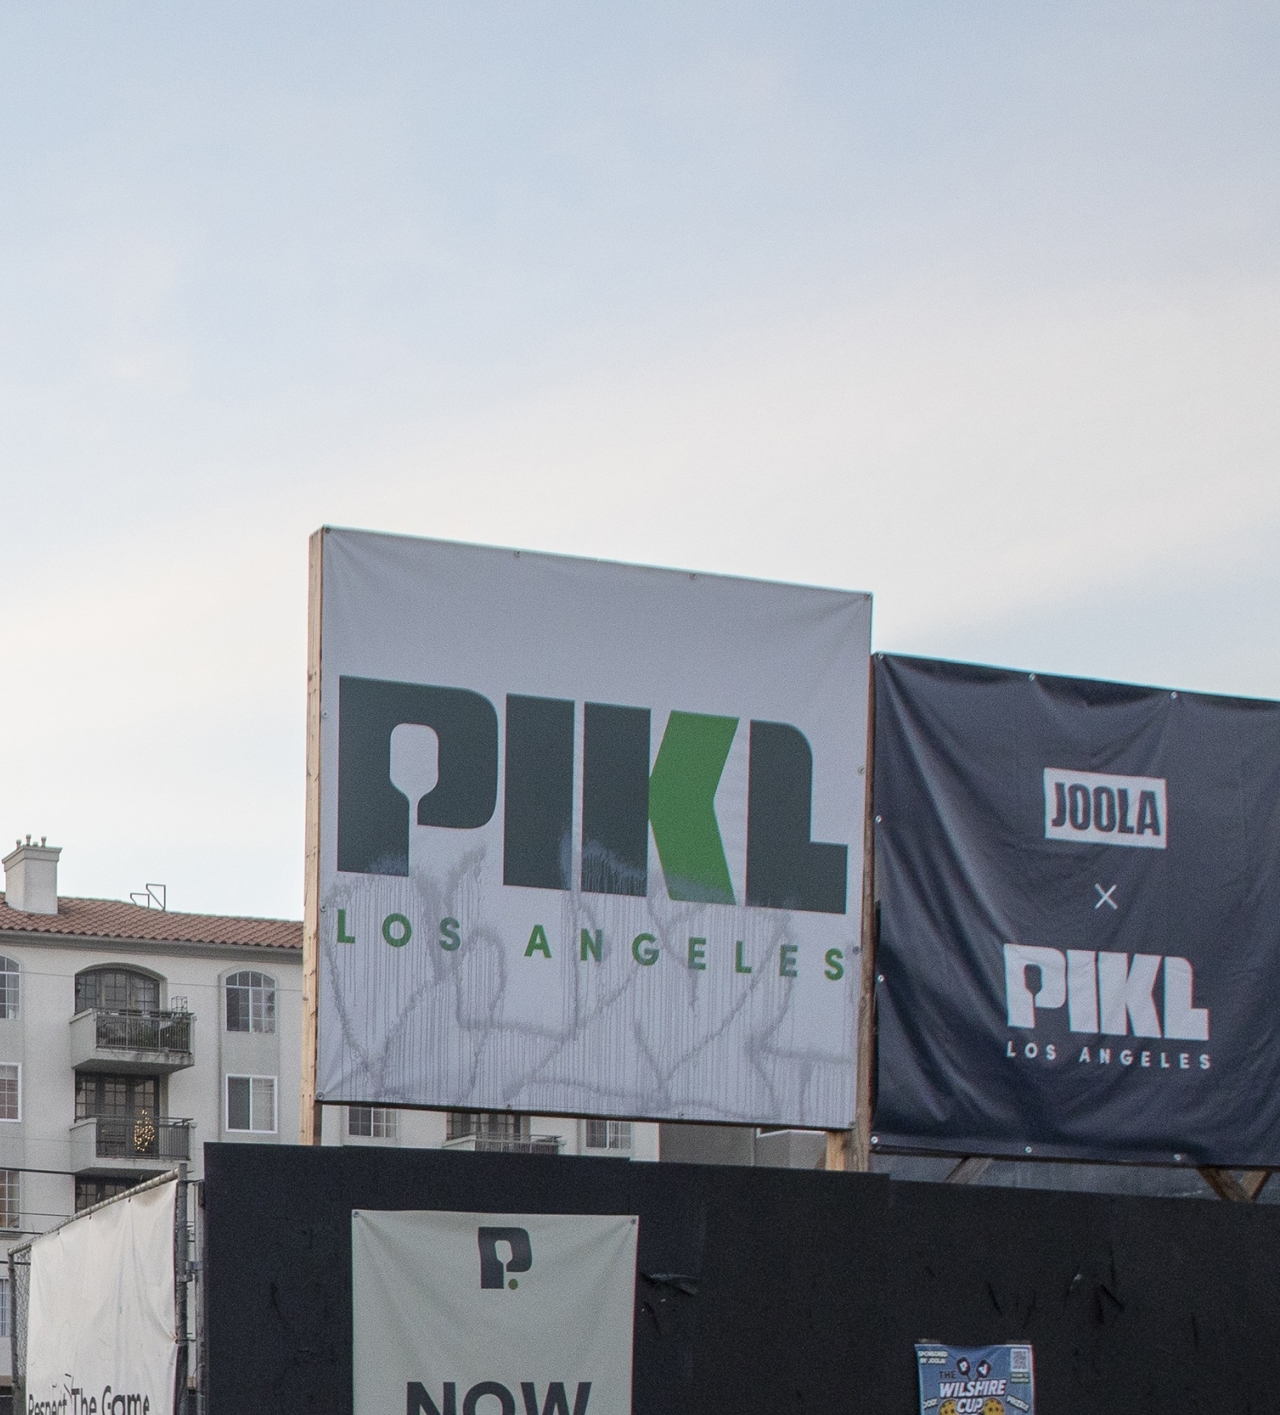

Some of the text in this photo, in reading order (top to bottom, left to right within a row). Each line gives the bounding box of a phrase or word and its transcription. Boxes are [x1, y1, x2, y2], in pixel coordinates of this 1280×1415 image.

[337, 675, 848, 914] PIKL
[1051, 782, 1161, 837] JOOLA
[337, 908, 845, 981] LOS ANGELES
[1004, 944, 1209, 1041] PIKL
[1007, 1041, 1211, 1070] LOS ANGELES
[940, 1370, 956, 1379] THE
[940, 1379, 1007, 1398] WILSHIRE
[957, 1398, 983, 1414] CUP
